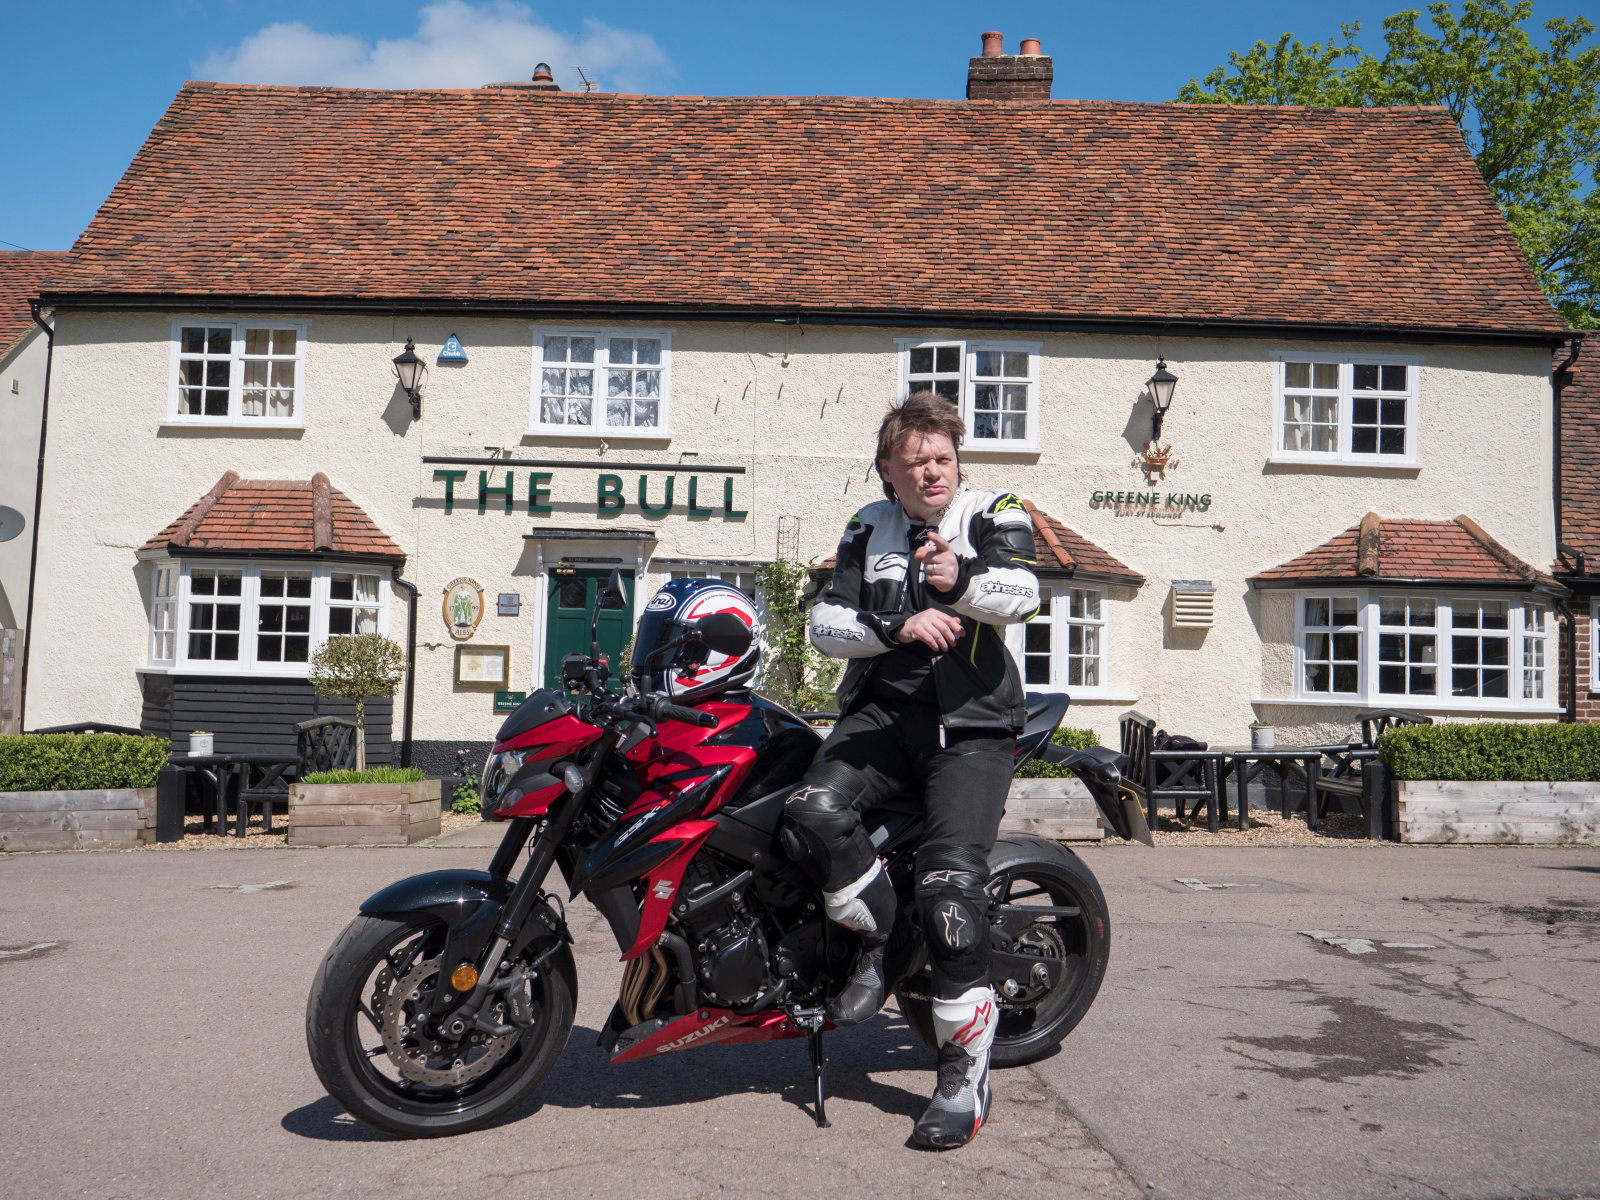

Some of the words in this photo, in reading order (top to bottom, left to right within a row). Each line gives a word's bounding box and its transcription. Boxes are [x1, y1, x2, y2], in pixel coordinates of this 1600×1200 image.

[433, 469, 553, 513] THE
[598, 473, 749, 518] BULL
[1093, 490, 1160, 505] GREENE
[1168, 493, 1212, 506] KING
[446, 577, 467, 589] GREENE
[467, 577, 482, 590] KING
[980, 580, 1034, 598] alpinestars
[812, 624, 863, 641] alpinestars
[656, 1015, 729, 1053] SUZUKI
